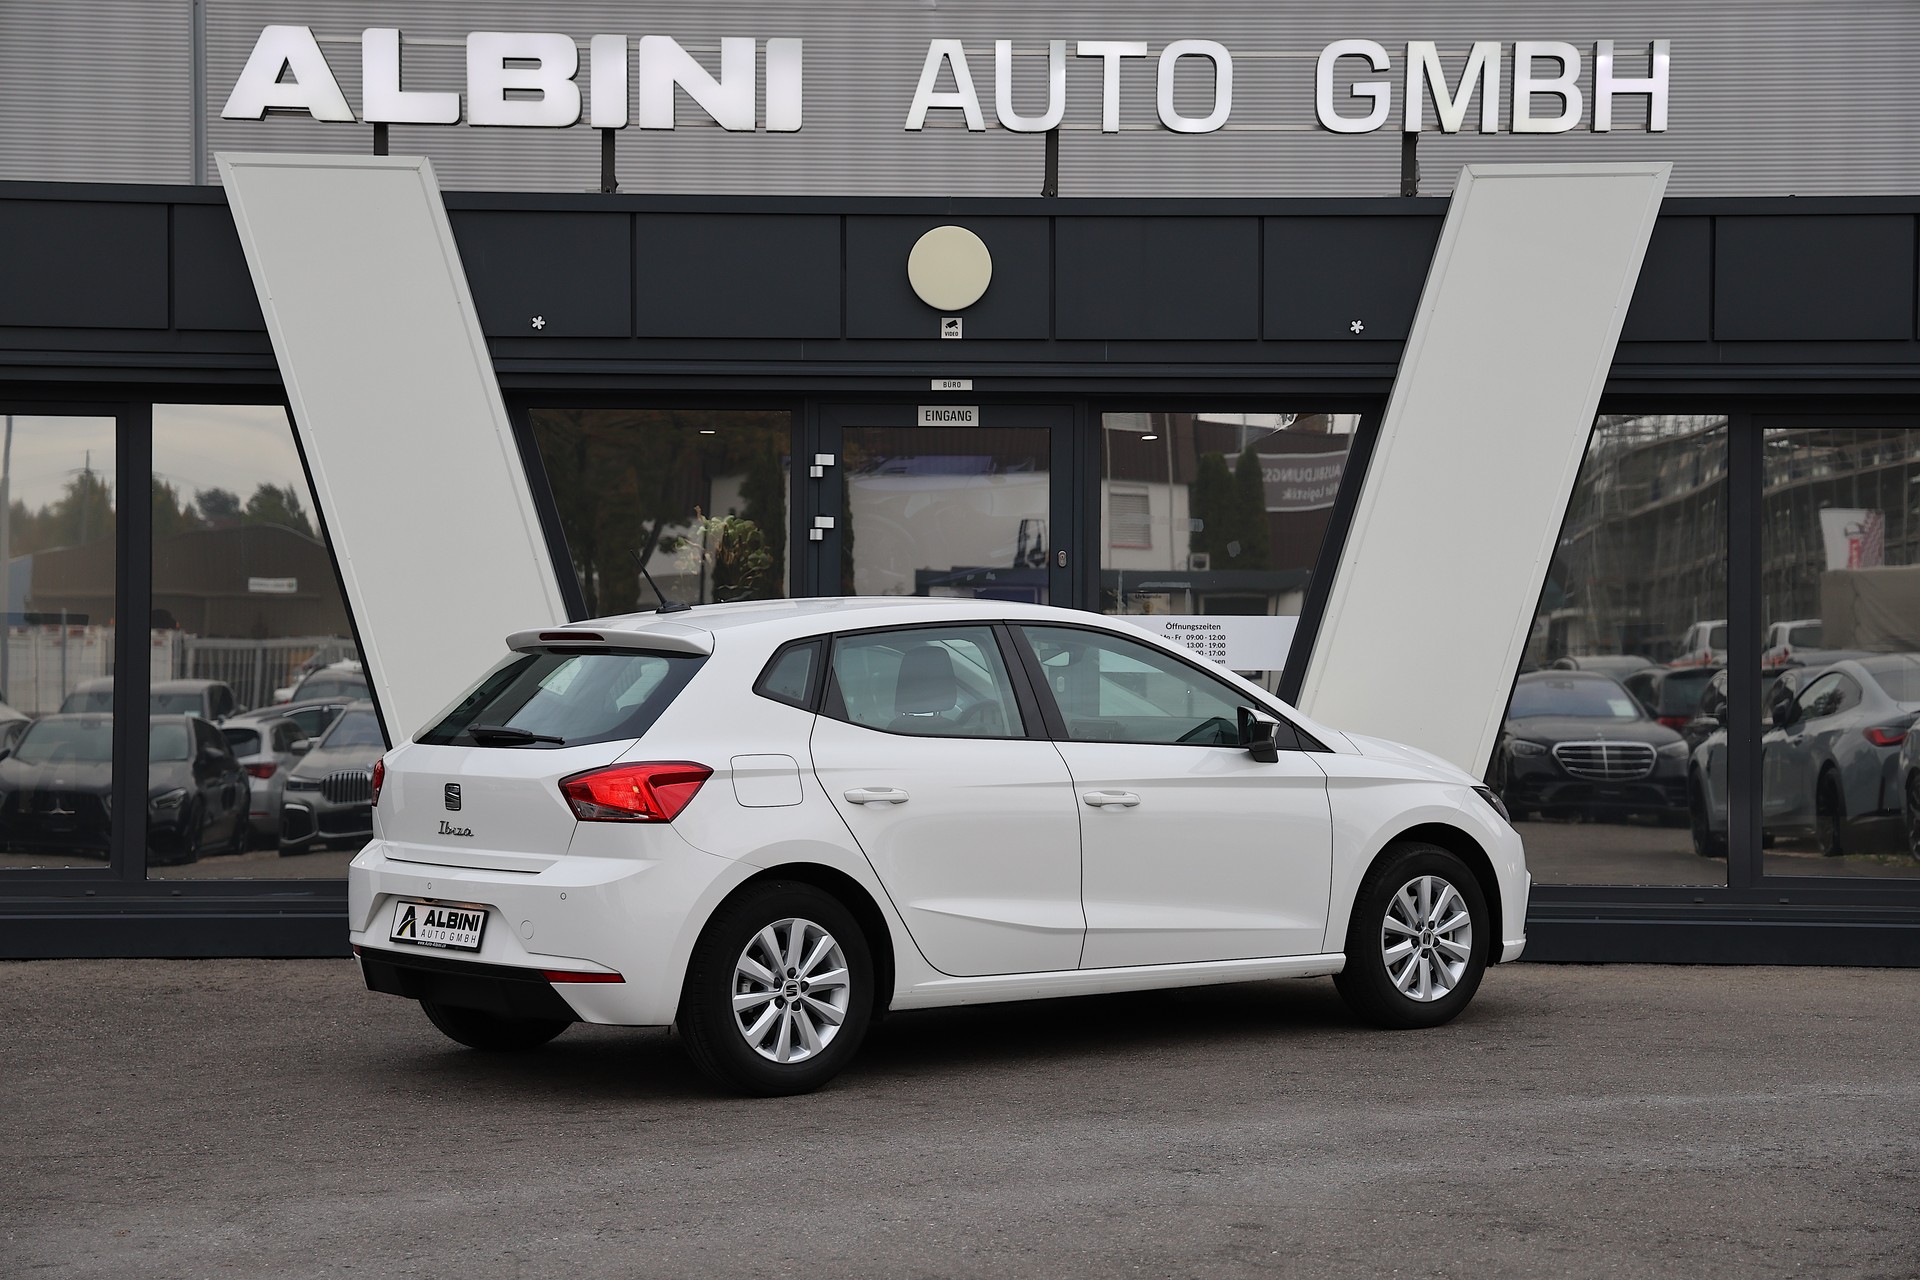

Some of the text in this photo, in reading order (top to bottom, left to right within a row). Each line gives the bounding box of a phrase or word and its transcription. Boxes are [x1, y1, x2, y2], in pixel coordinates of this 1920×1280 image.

[220, 24, 1671, 134] ALBINI AUTO GMBH
[925, 410, 972, 422] EINGANG
[1165, 622, 1221, 631] Öffnungszeiten
[438, 820, 474, 837] Ibiza
[423, 909, 480, 931] ALBINI
[421, 929, 477, 943] AUTO GMBH
